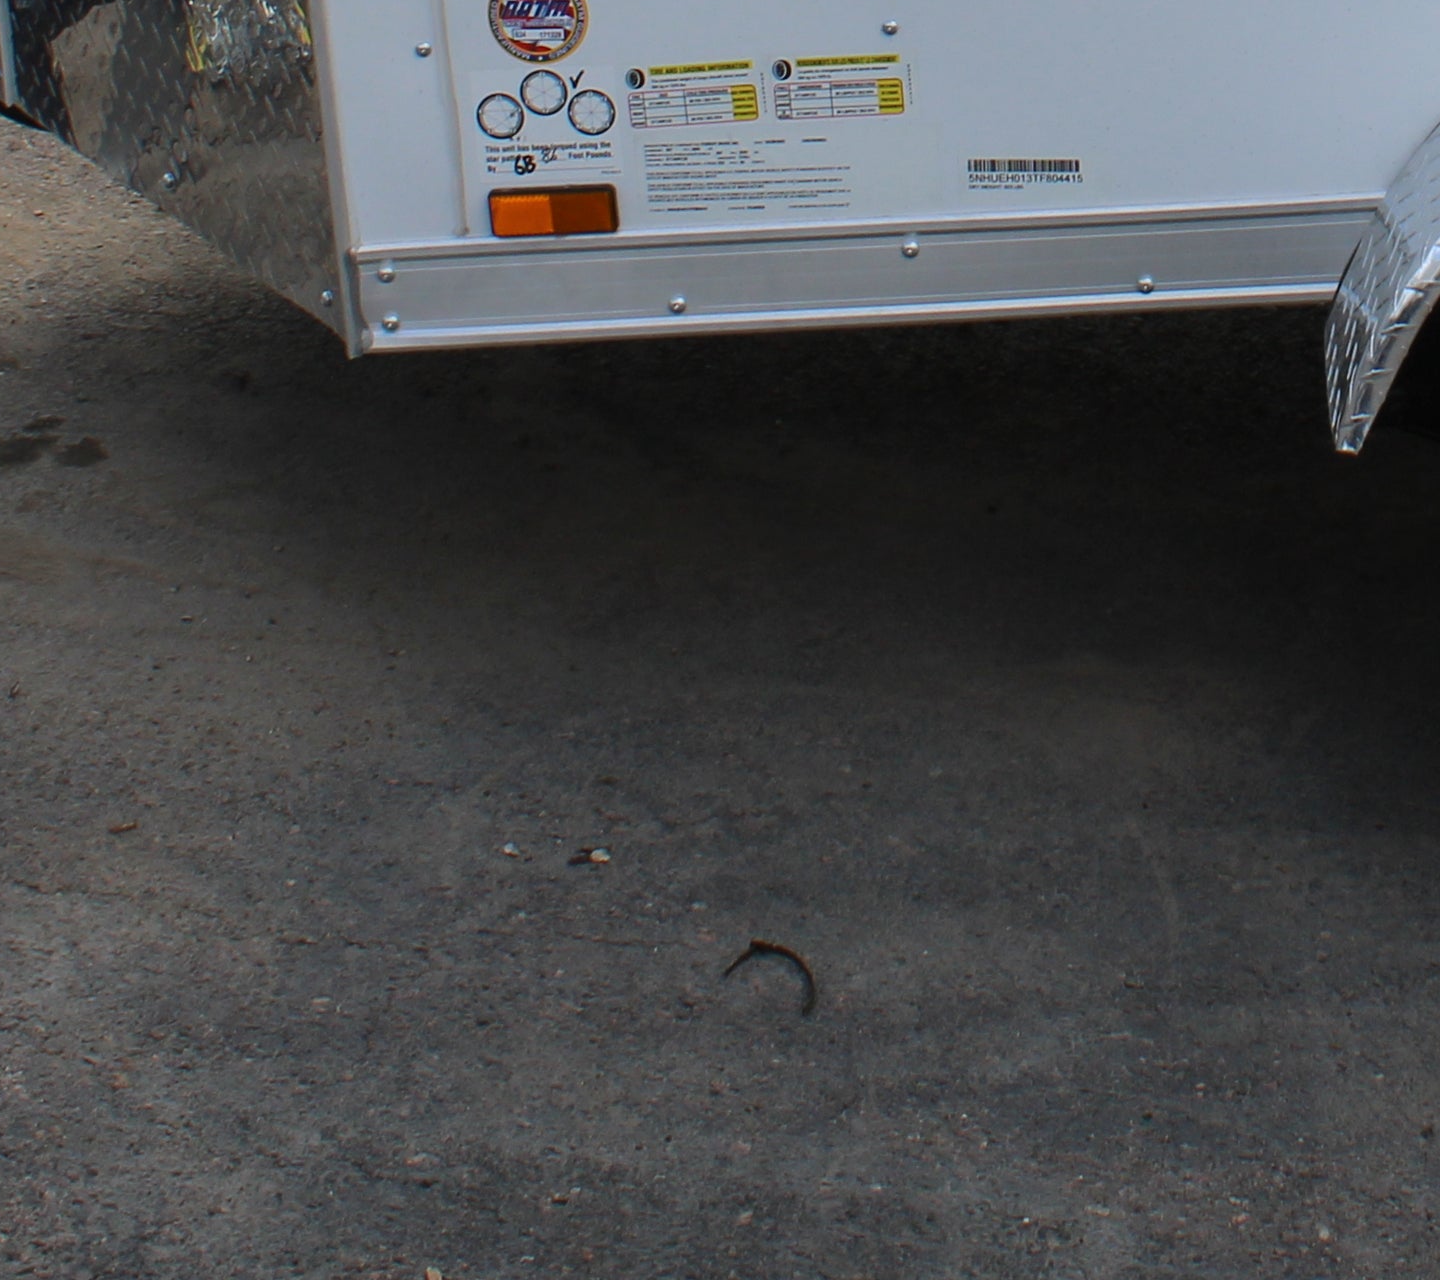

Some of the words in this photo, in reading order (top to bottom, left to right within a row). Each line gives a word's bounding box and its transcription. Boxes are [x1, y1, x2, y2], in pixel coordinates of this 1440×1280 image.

[485, 145, 500, 153] This
[517, 144, 529, 152] has
[579, 142, 598, 150] using
